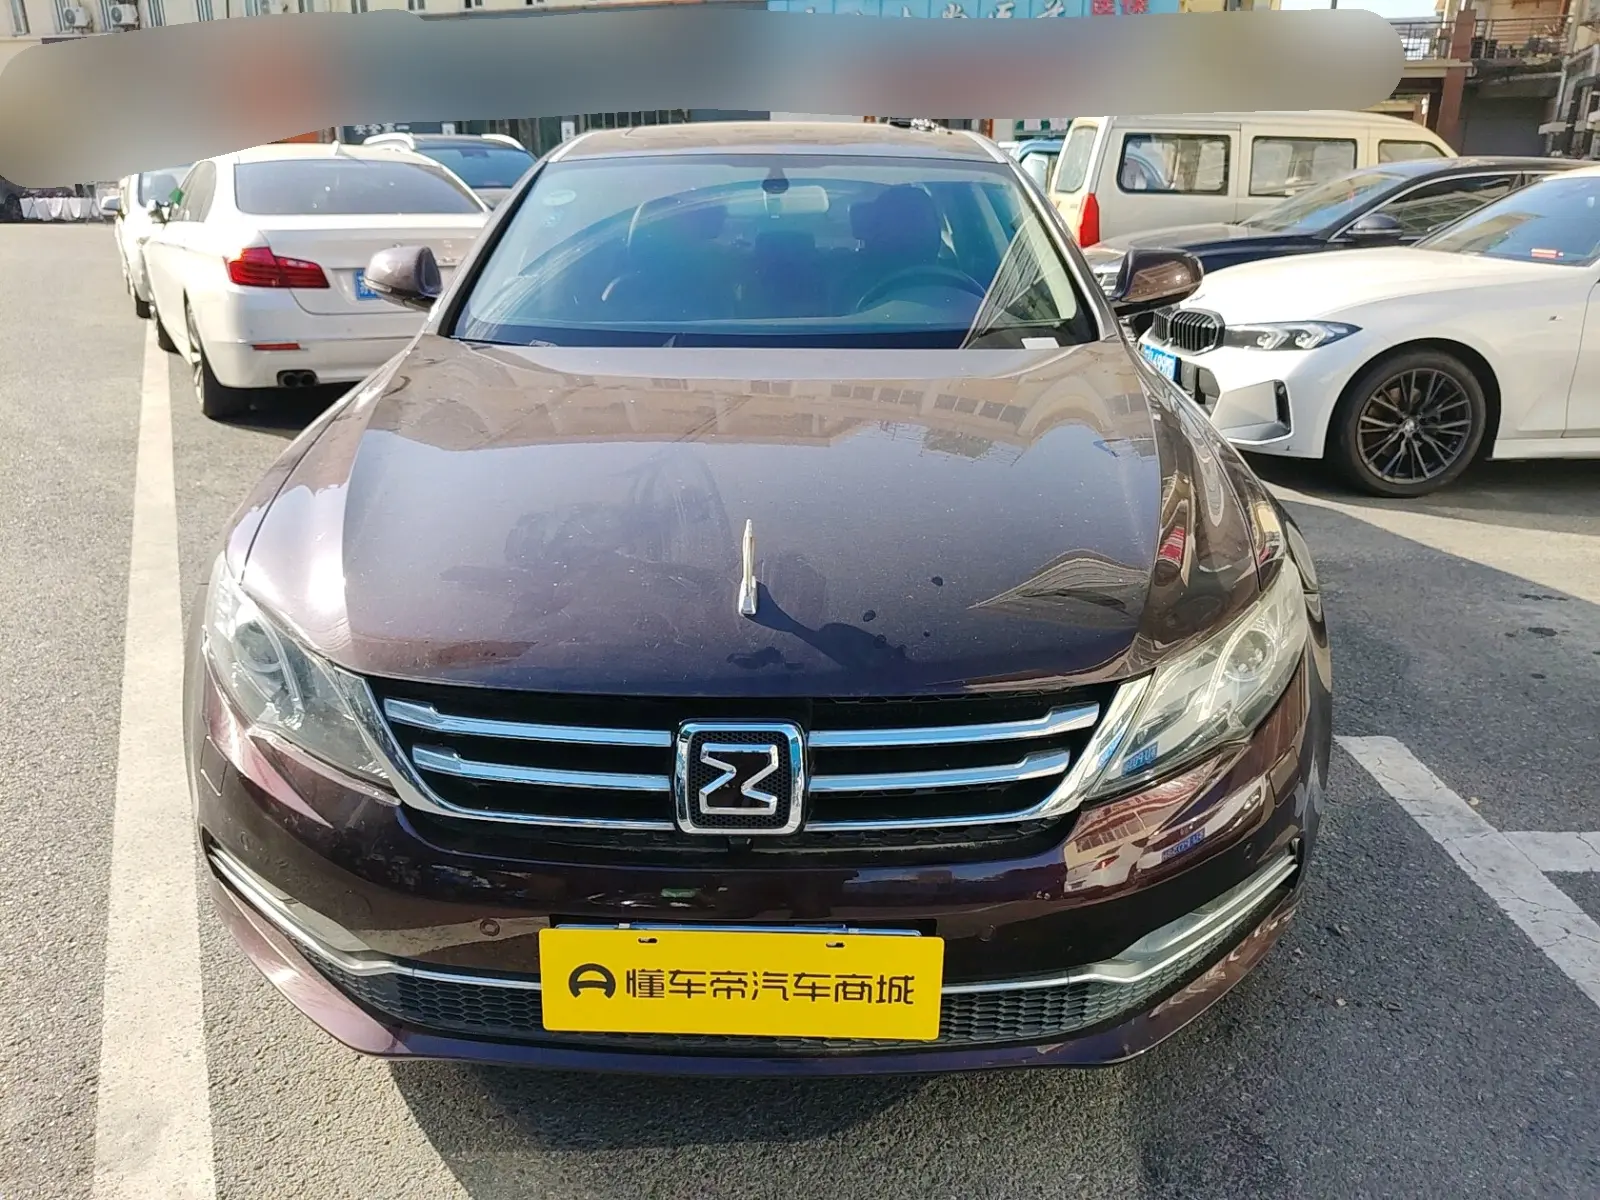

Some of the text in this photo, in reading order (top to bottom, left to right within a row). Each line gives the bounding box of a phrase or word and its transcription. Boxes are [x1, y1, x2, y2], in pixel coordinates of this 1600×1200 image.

[625, 968, 915, 1005] 懂车帝汽车商城
